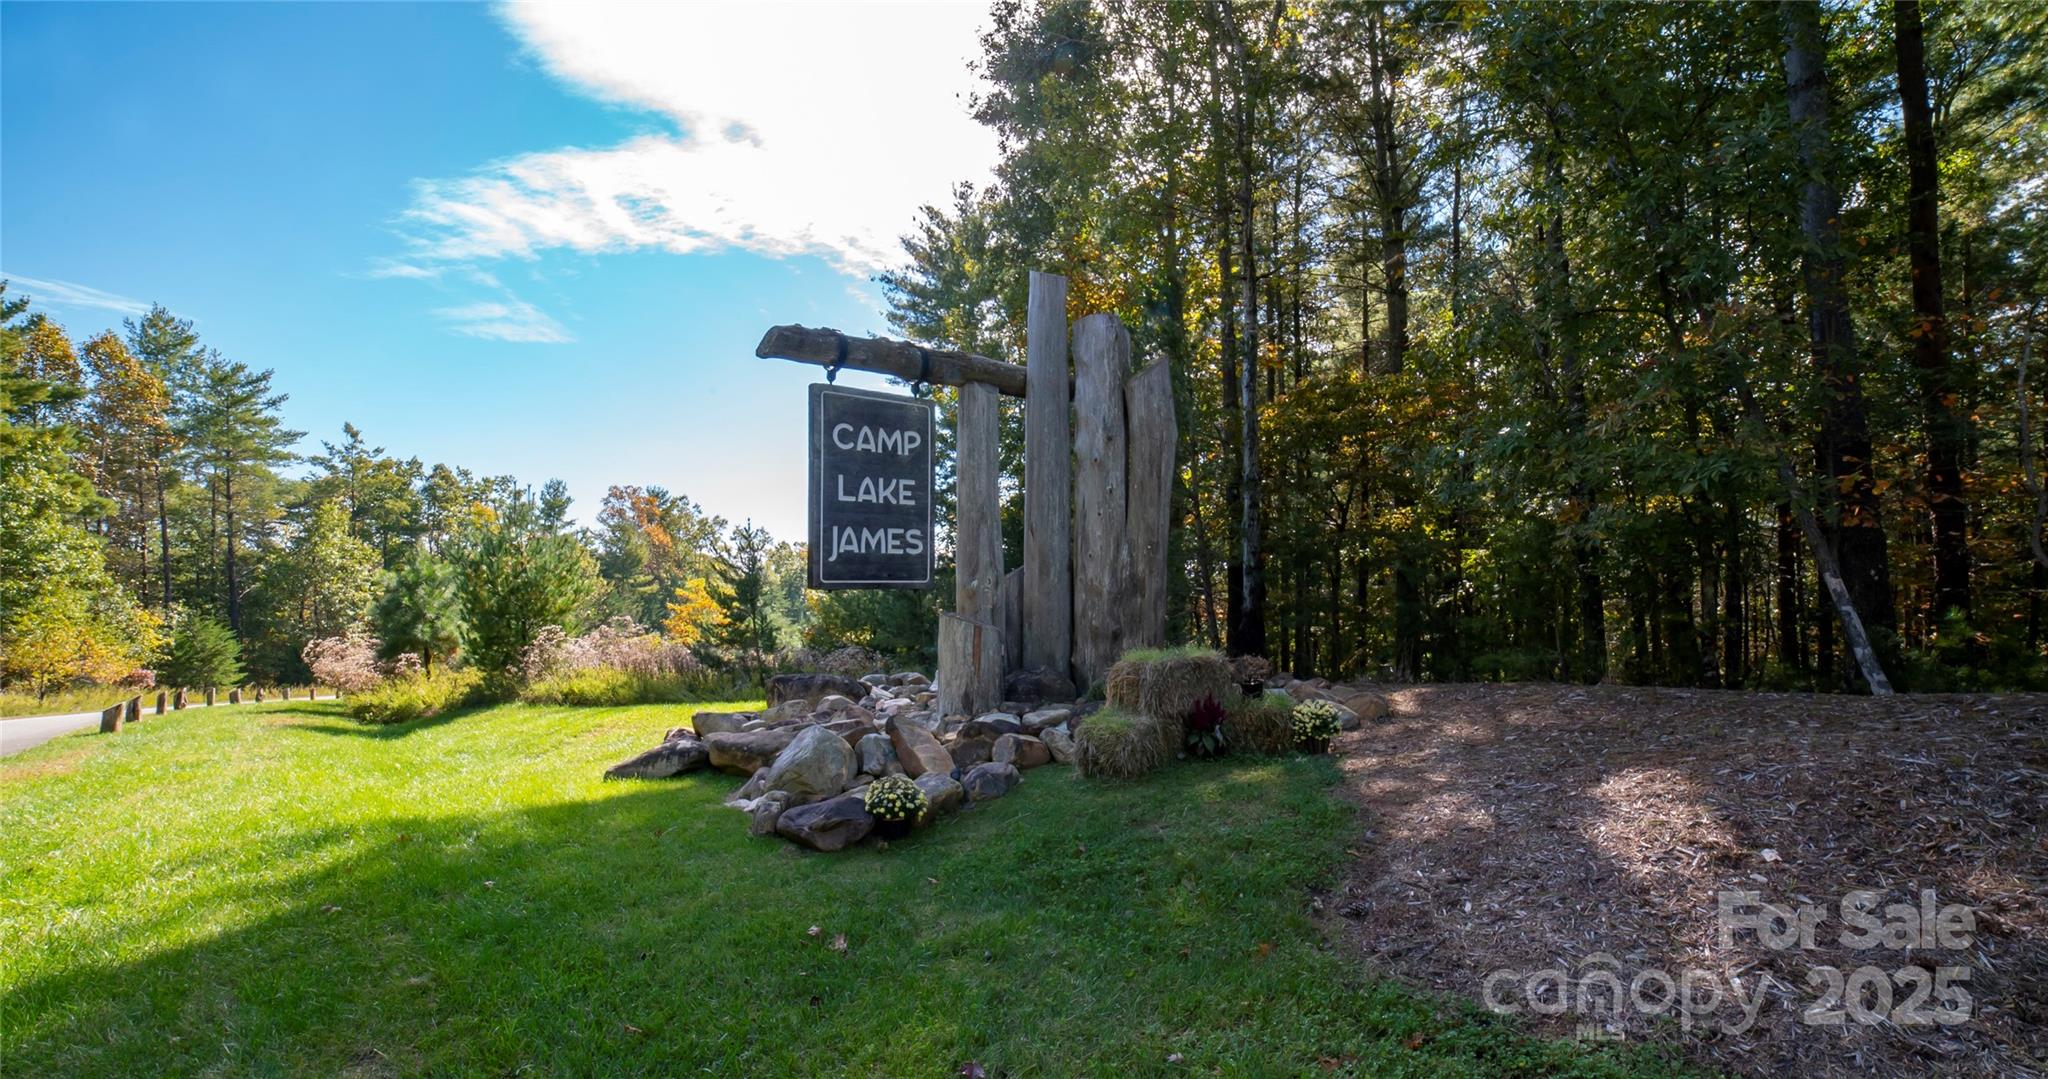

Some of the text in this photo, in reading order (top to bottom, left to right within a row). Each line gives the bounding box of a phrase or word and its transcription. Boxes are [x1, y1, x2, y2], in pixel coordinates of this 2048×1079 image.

[832, 423, 921, 455] CAMP
[838, 474, 916, 505] LAKE
[828, 525, 924, 562] JAMES
